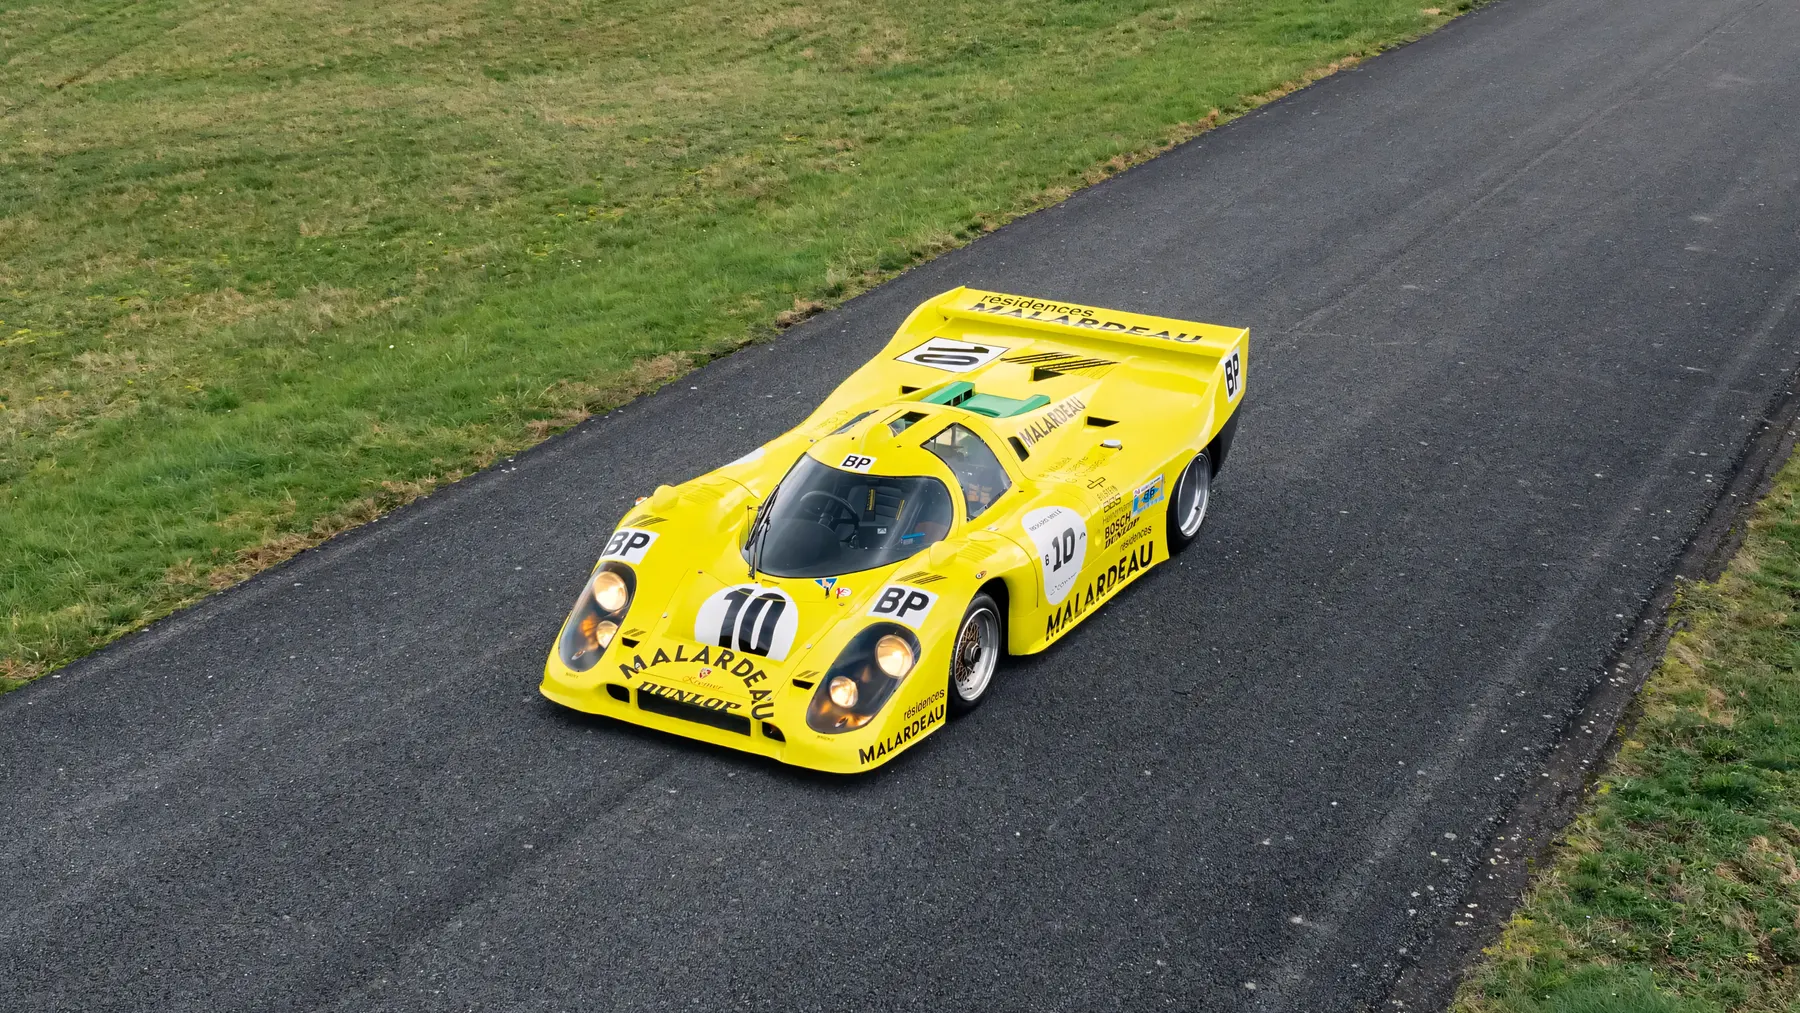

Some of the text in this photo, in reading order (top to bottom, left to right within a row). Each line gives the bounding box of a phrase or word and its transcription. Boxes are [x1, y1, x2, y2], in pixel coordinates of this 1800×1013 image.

[968, 302, 1203, 344] MALARDEAU
[913, 346, 990, 366] 10
[1224, 352, 1240, 397] BP
[1018, 396, 1086, 448] MALARDEAU
[841, 455, 871, 469] BP
[601, 531, 651, 557] BP
[1104, 510, 1131, 540] BOSCH
[1051, 527, 1076, 573] 10
[872, 587, 930, 618] BP
[1045, 540, 1154, 642] MALARDEAU
[718, 587, 787, 657] 10
[618, 644, 775, 721] MALARDEAU
[637, 681, 742, 714] DUNLOP
[903, 688, 946, 721] résidences
[858, 704, 945, 766] MALARDEAU
